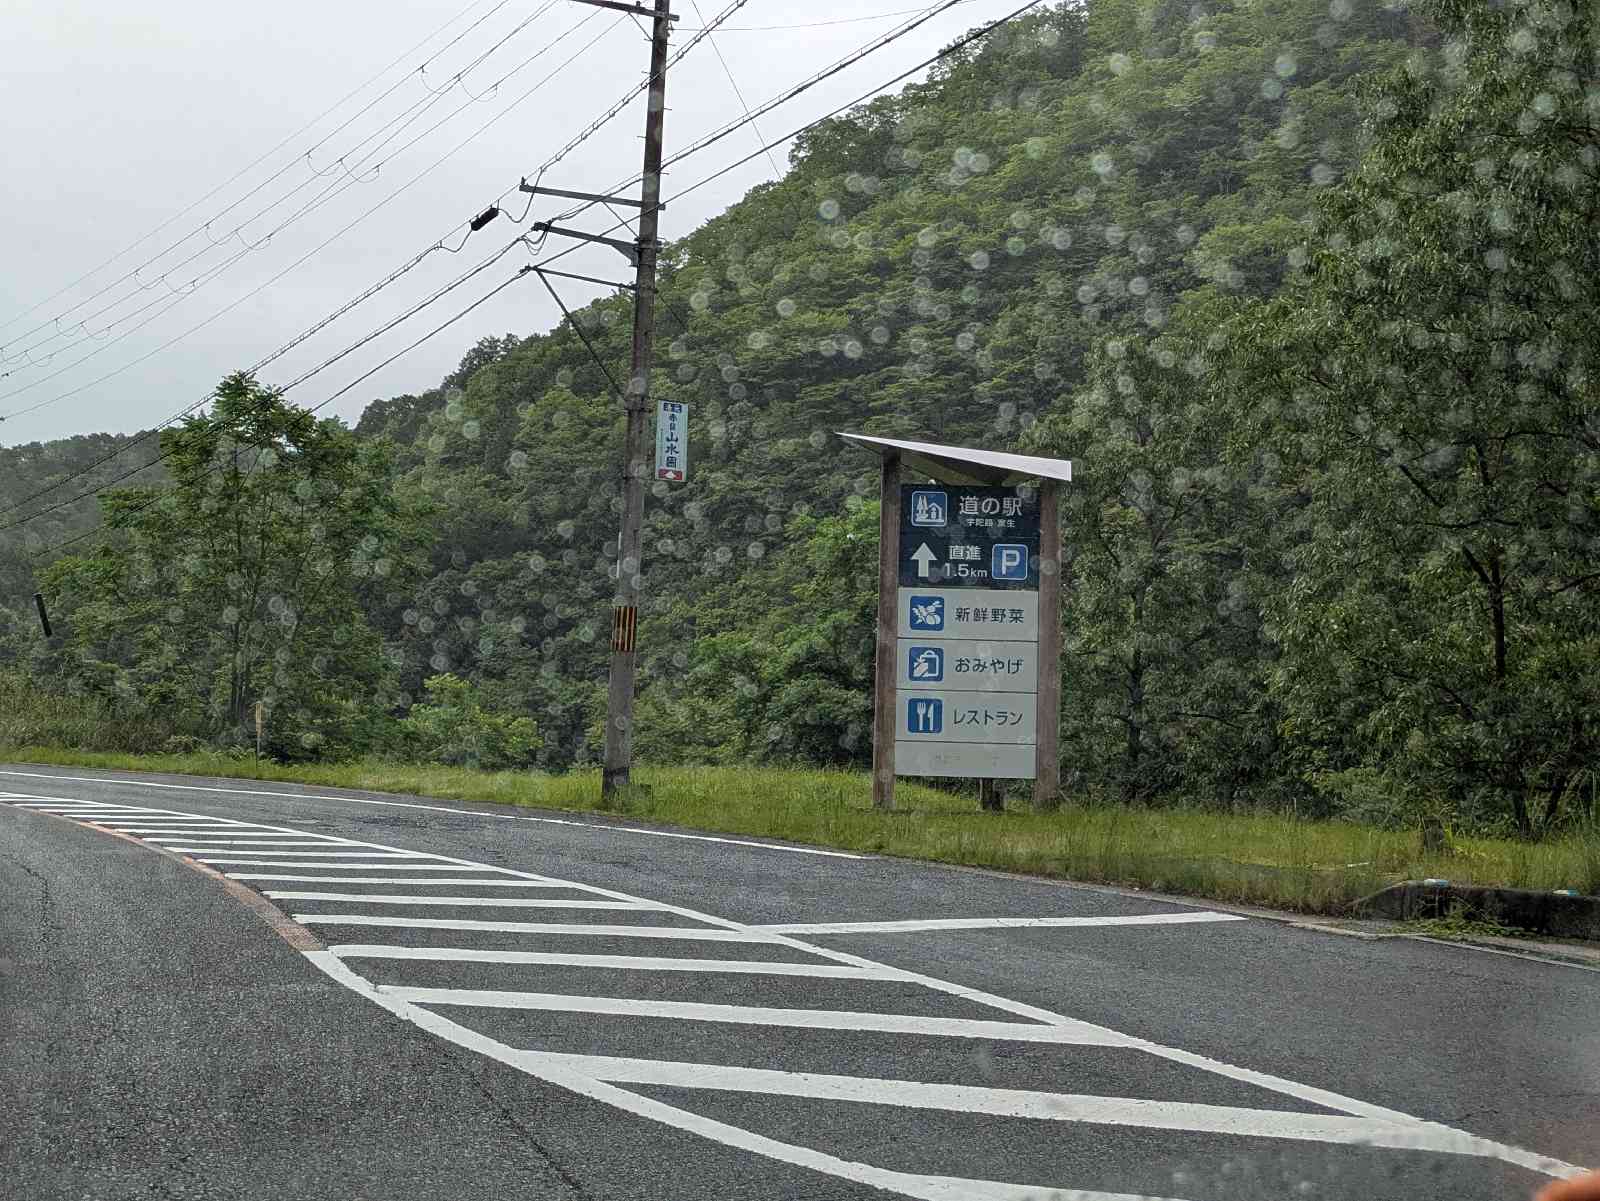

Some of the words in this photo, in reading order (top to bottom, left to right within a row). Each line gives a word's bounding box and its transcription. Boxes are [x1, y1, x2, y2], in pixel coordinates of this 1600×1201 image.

[959, 496, 1022, 516] 道の駅
[948, 545, 981, 560] 直進
[944, 563, 987, 577] 1.5km
[1001, 550, 1020, 575] P
[955, 607, 1024, 623] 新鮮野菜
[955, 657, 1023, 674] おみやげ
[953, 709, 1023, 725] レストラン
